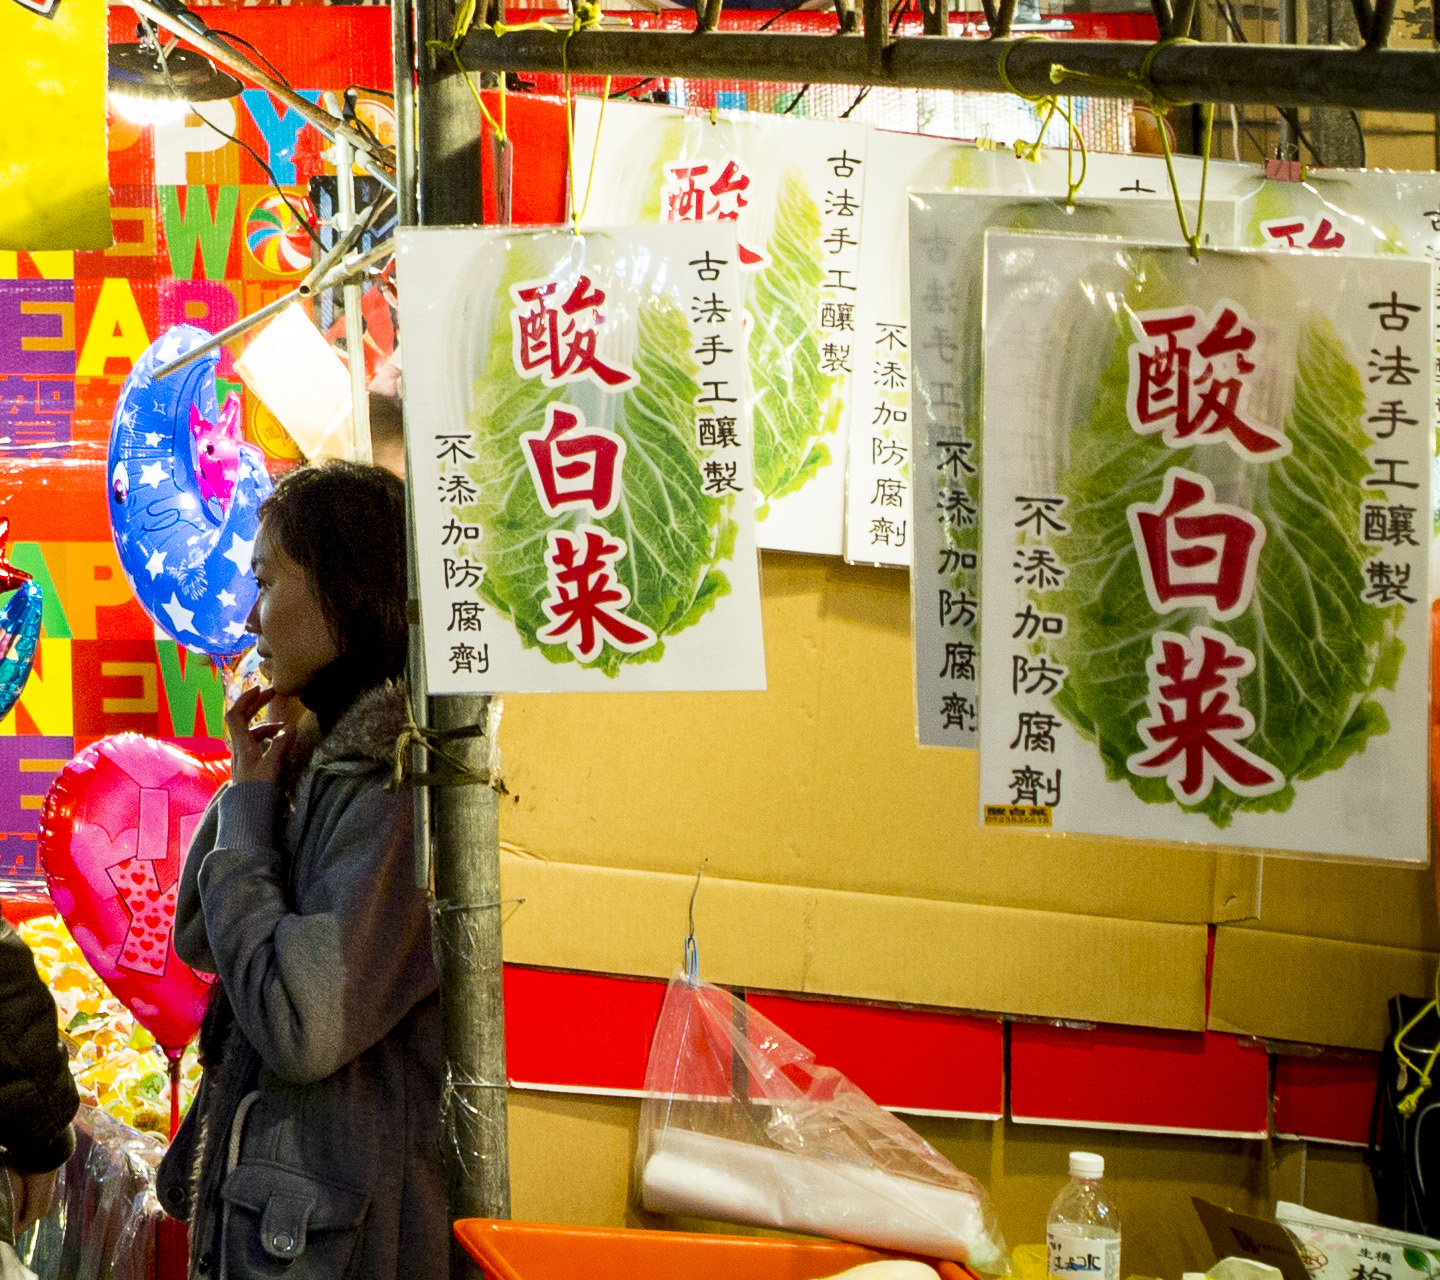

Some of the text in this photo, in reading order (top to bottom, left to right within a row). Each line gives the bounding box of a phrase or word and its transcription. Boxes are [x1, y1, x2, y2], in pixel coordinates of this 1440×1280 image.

[688, 250, 745, 496] 古法手工釀製
[820, 148, 862, 377] 古法手工釀製
[436, 434, 491, 678] 不添加防腐劑
[515, 276, 652, 654] 酸白菜
[869, 321, 908, 548] 不添加防腐劑
[1134, 308, 1286, 800] 酸白菜
[1363, 290, 1422, 606] 古法手工釀製
[1009, 496, 1067, 809] 不添加防腐劑
